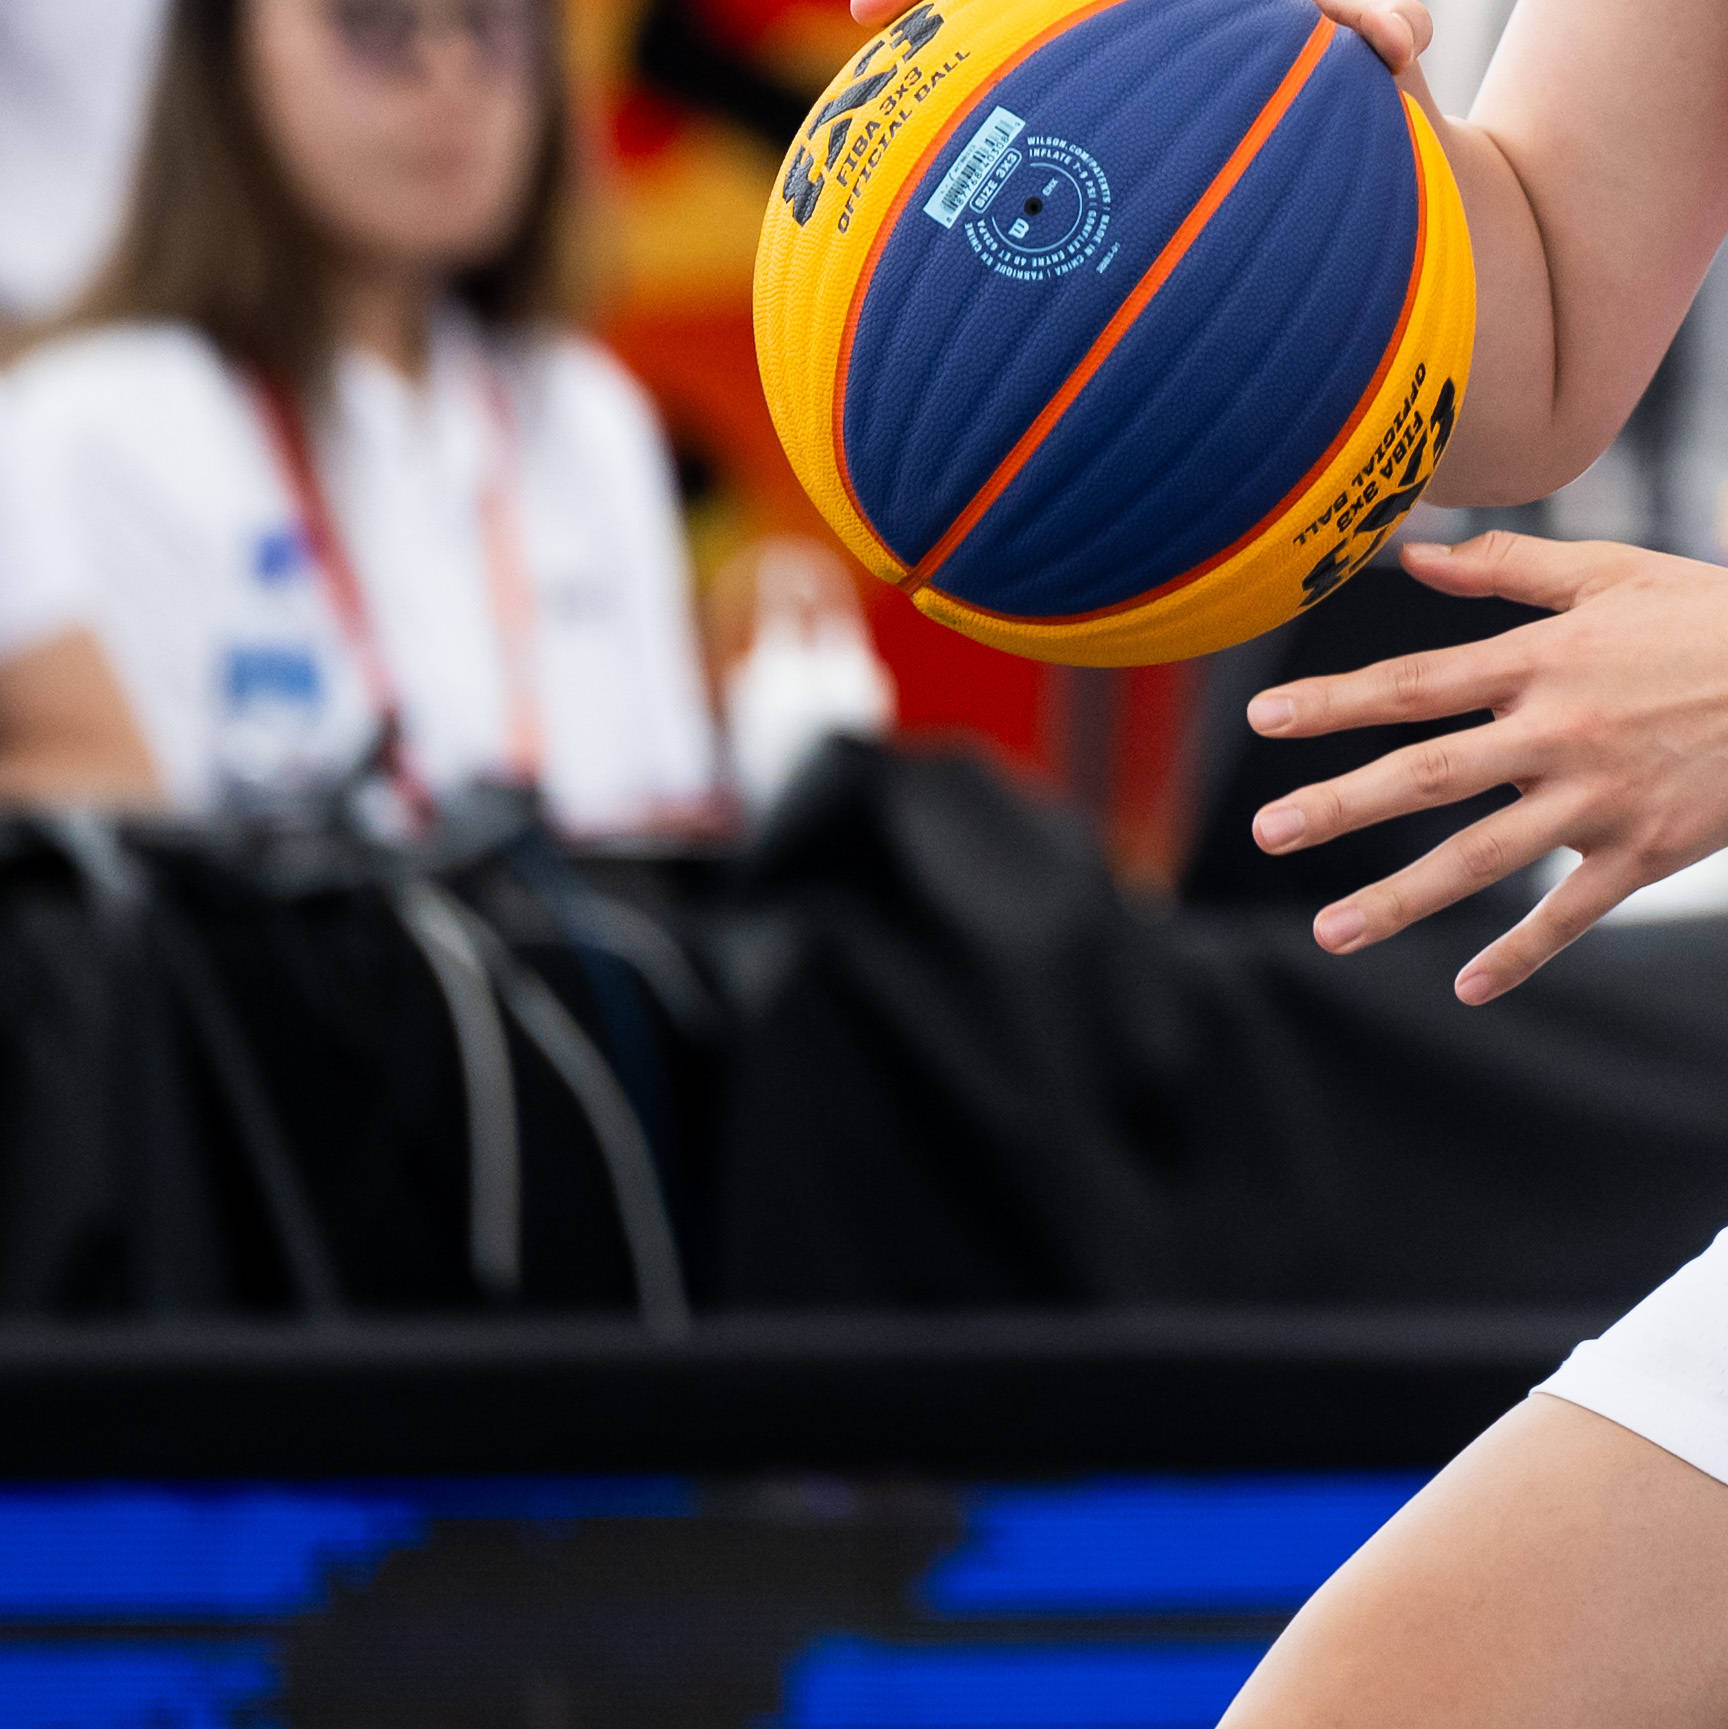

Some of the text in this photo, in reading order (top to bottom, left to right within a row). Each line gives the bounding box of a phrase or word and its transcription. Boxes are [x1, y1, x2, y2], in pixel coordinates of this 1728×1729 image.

[836, 120, 881, 187] FIBA
[837, 51, 971, 234] OFFICIAL BALL
[1029, 148, 1072, 165] INFLATE
[975, 153, 1017, 209] SIZE 3X3
[1055, 254, 1084, 276] CHINA
[1293, 362, 1426, 546] OFFICIAL BALL
[1380, 410, 1424, 480] FIBA
